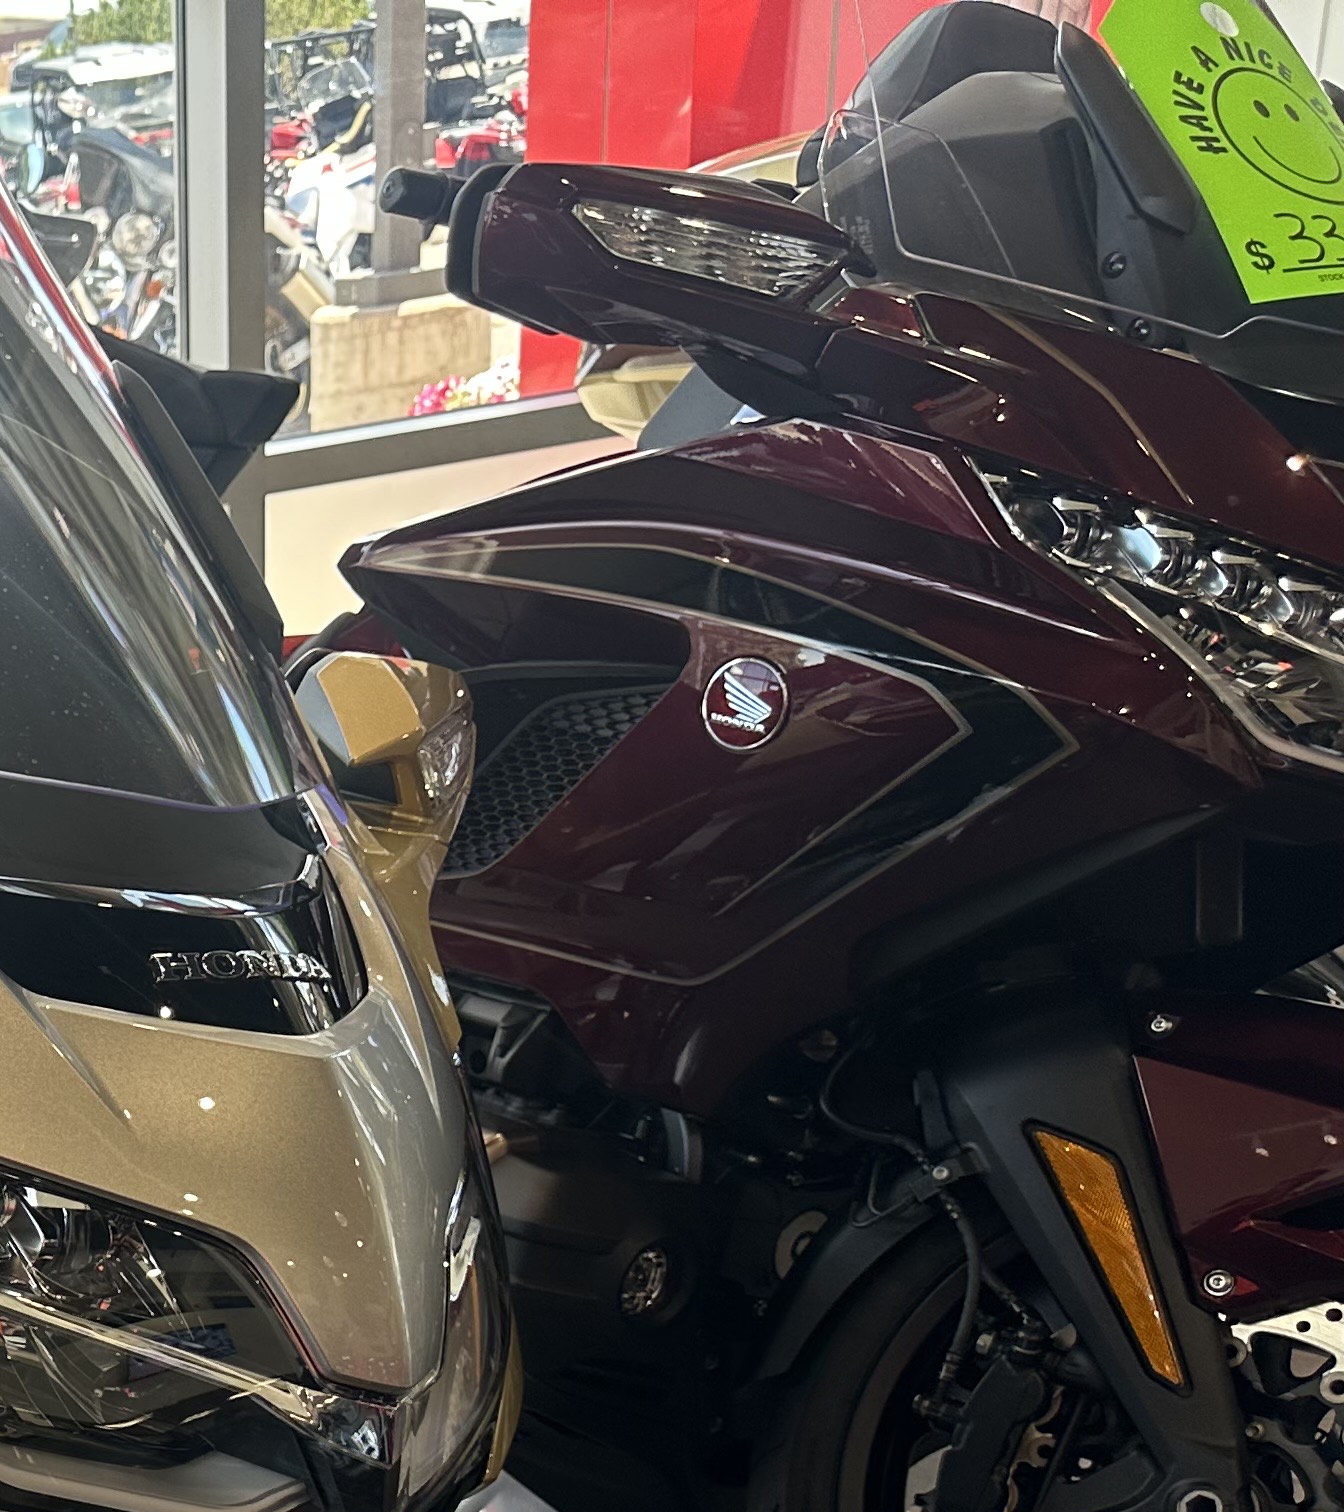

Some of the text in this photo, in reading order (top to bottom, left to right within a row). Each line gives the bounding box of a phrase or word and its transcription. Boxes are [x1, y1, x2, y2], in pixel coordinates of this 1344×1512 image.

[1190, 46, 1220, 73] A
[1220, 36, 1293, 84] NICE
[1172, 70, 1229, 155] HAVE
[1244, 237, 1276, 276] $
[710, 712, 766, 735] HONDA
[149, 949, 333, 985] HONDA
